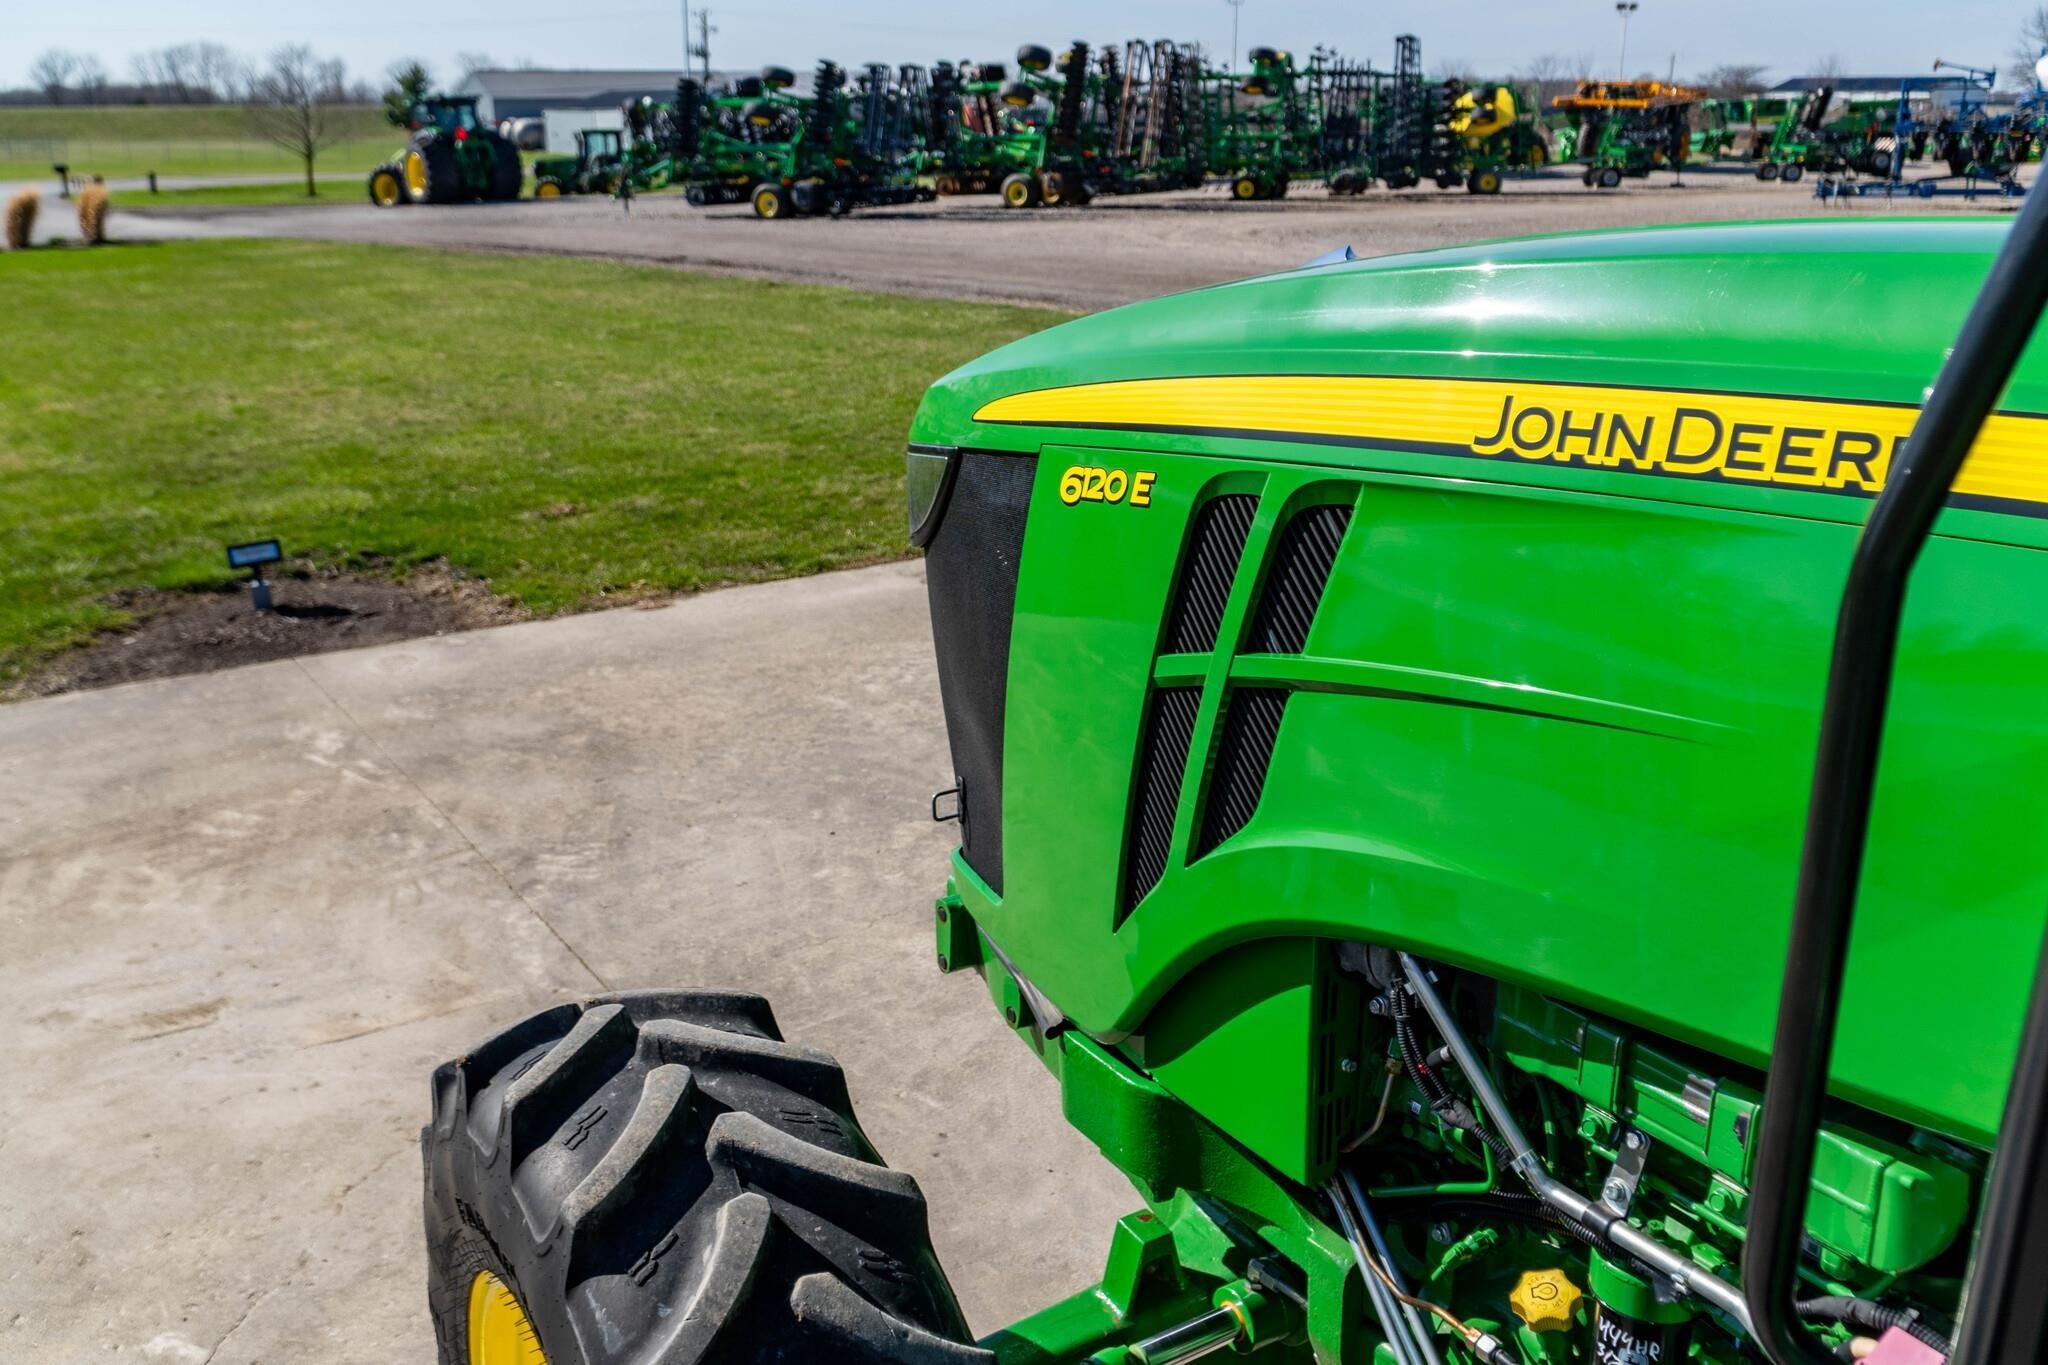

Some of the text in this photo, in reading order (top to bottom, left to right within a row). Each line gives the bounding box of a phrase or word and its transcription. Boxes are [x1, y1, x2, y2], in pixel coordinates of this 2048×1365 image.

[1473, 394, 1908, 484] JOHN DEER
[1060, 466, 1129, 505] 6120
